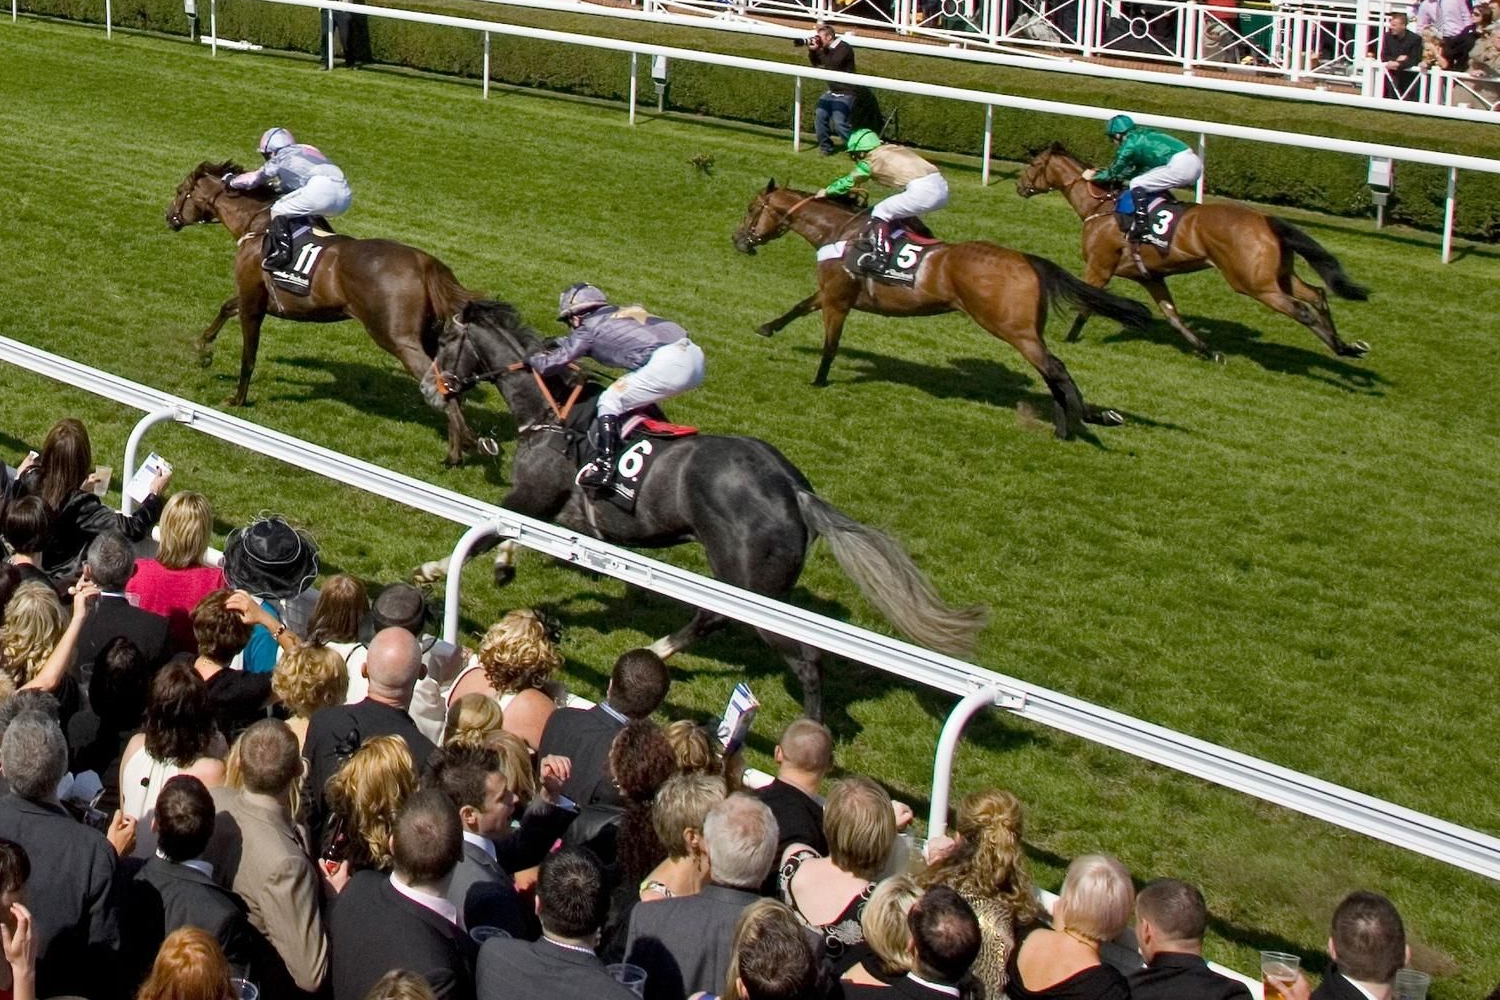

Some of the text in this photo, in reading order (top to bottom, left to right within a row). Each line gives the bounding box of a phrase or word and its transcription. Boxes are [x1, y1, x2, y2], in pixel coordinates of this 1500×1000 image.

[1152, 209, 1174, 235] 3
[293, 242, 324, 275] 11
[896, 243, 924, 269] 5
[618, 439, 653, 478] 6
